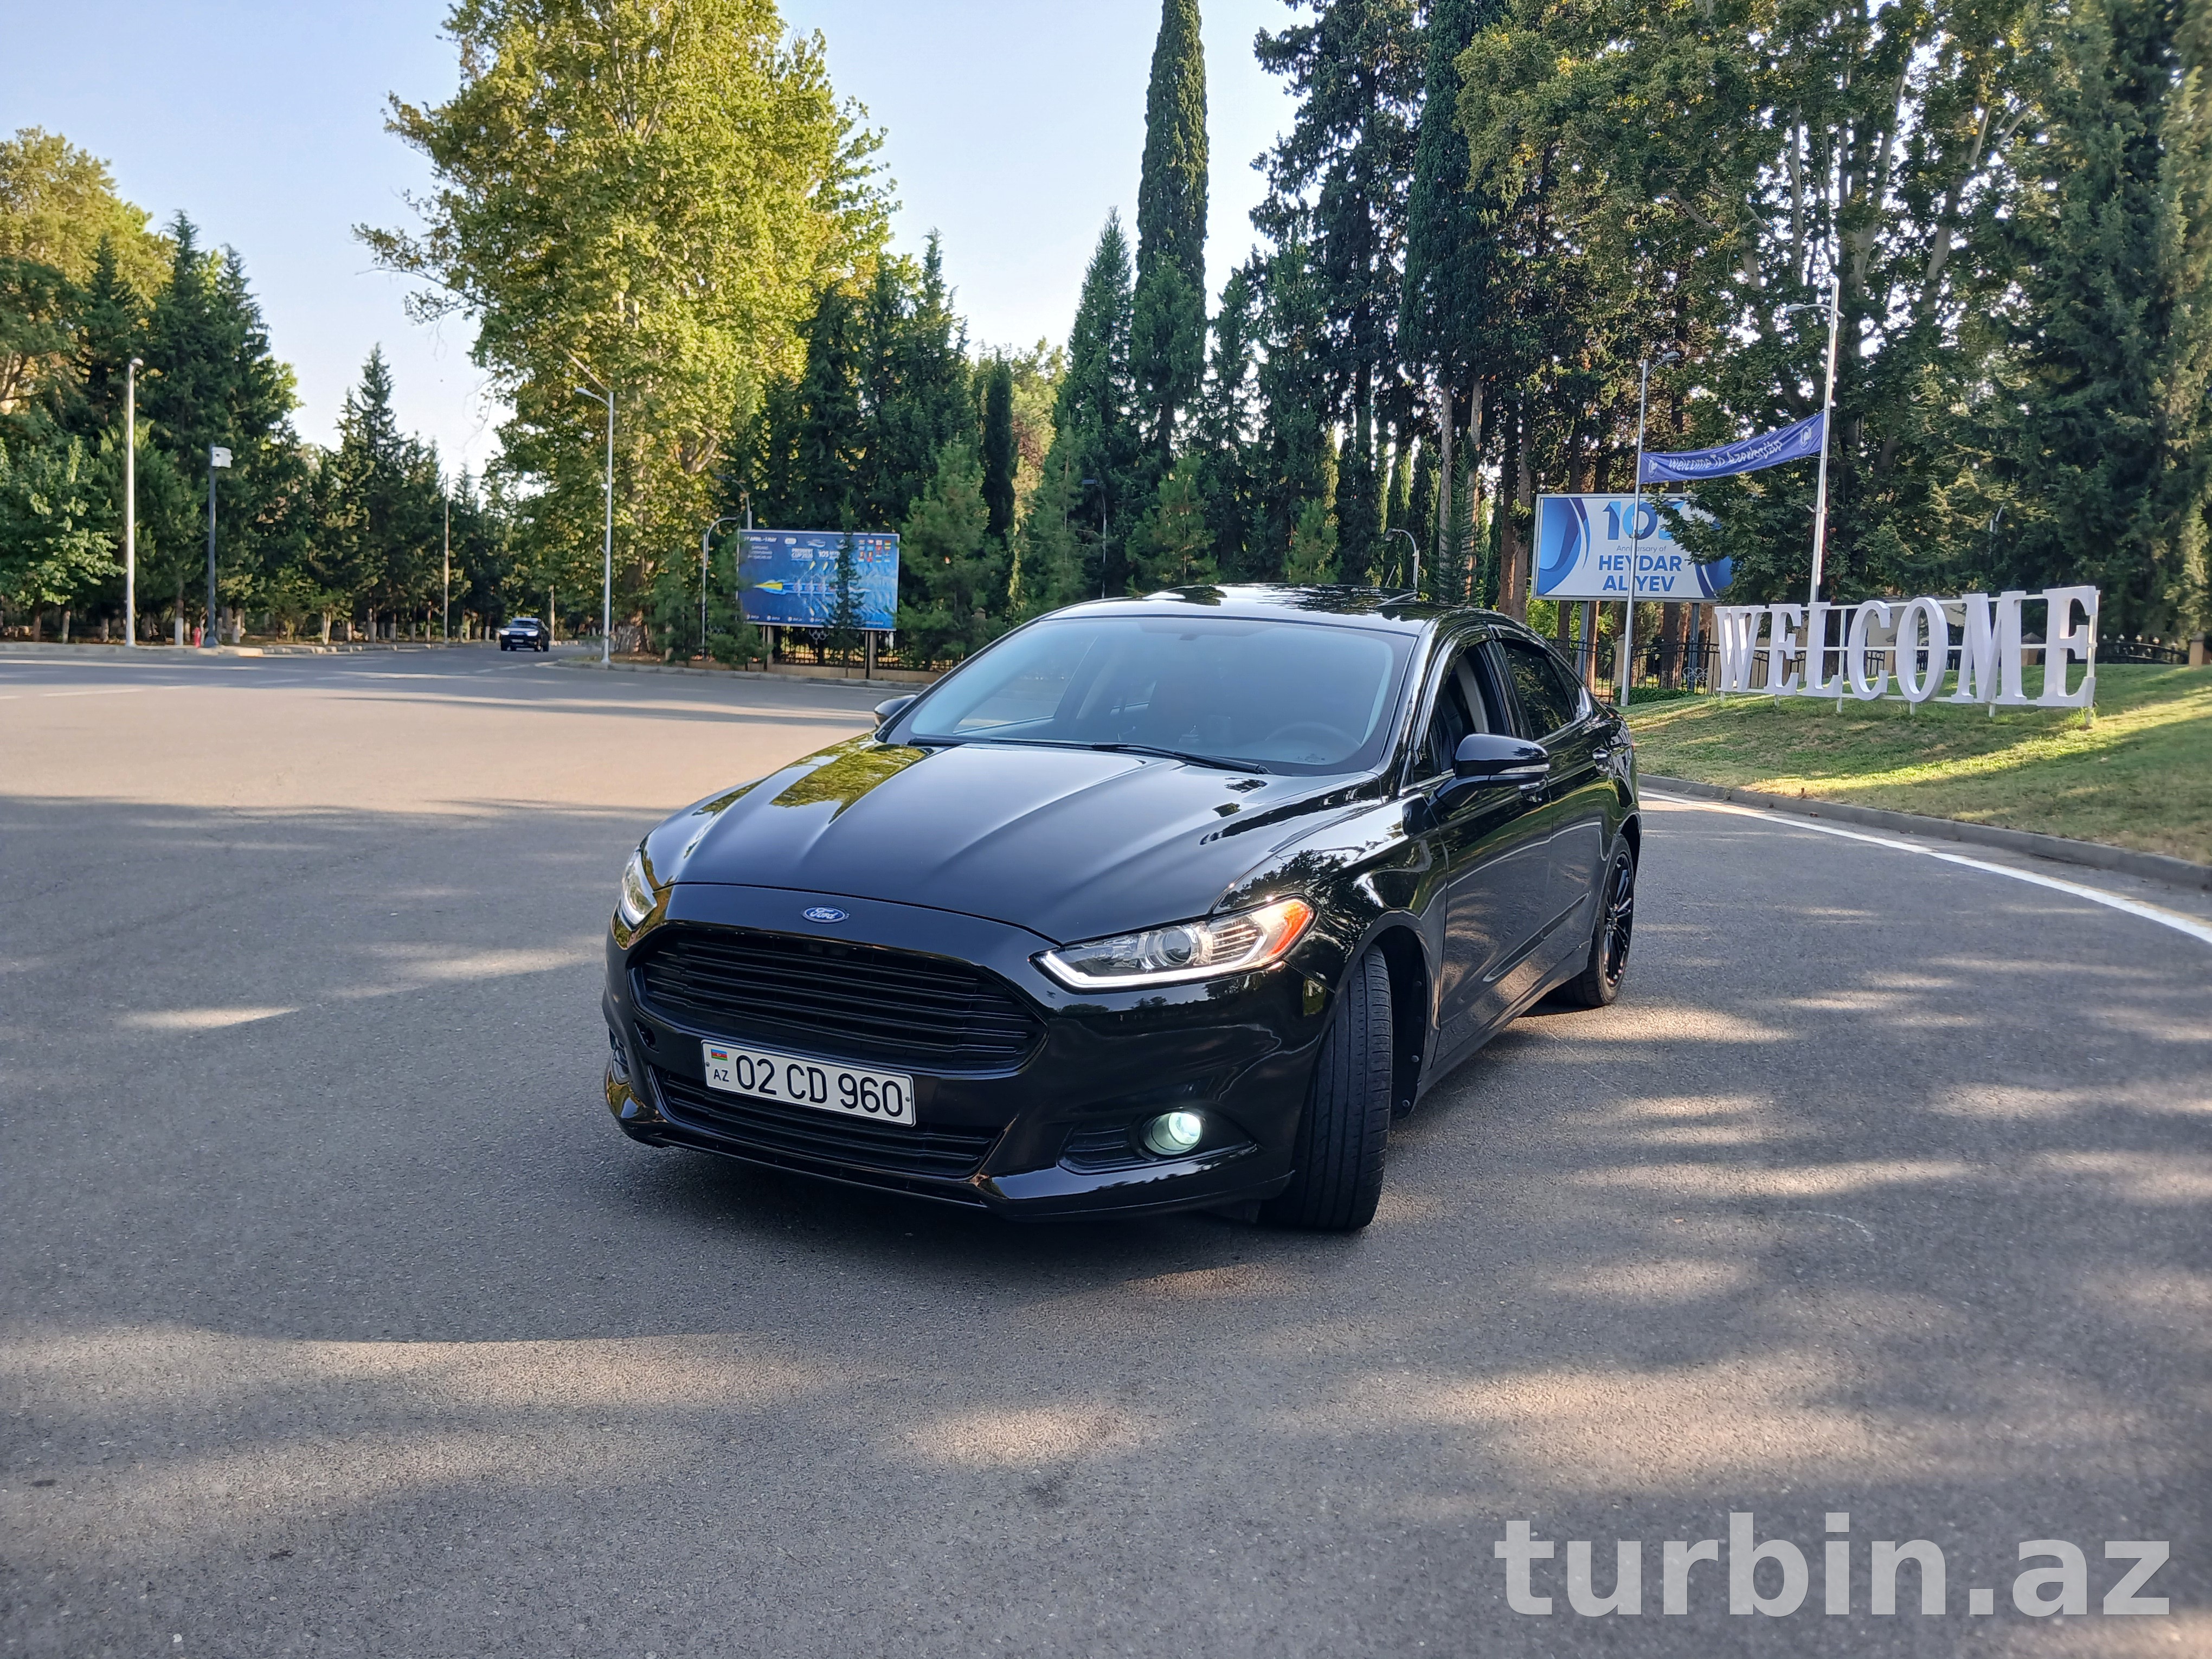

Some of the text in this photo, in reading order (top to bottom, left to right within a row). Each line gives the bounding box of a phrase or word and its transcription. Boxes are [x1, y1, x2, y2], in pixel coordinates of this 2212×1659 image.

[1668, 458, 1712, 471] Welcome
[1709, 454, 1726, 467] To
[1599, 555, 1682, 571] HEYDAR
[1602, 575, 1675, 591] ALYEV
[1714, 586, 2096, 707] WELCOME
[809, 908, 839, 919] Ford
[713, 1069, 730, 1083] AZ
[736, 1054, 903, 1117] 02 CD 960
